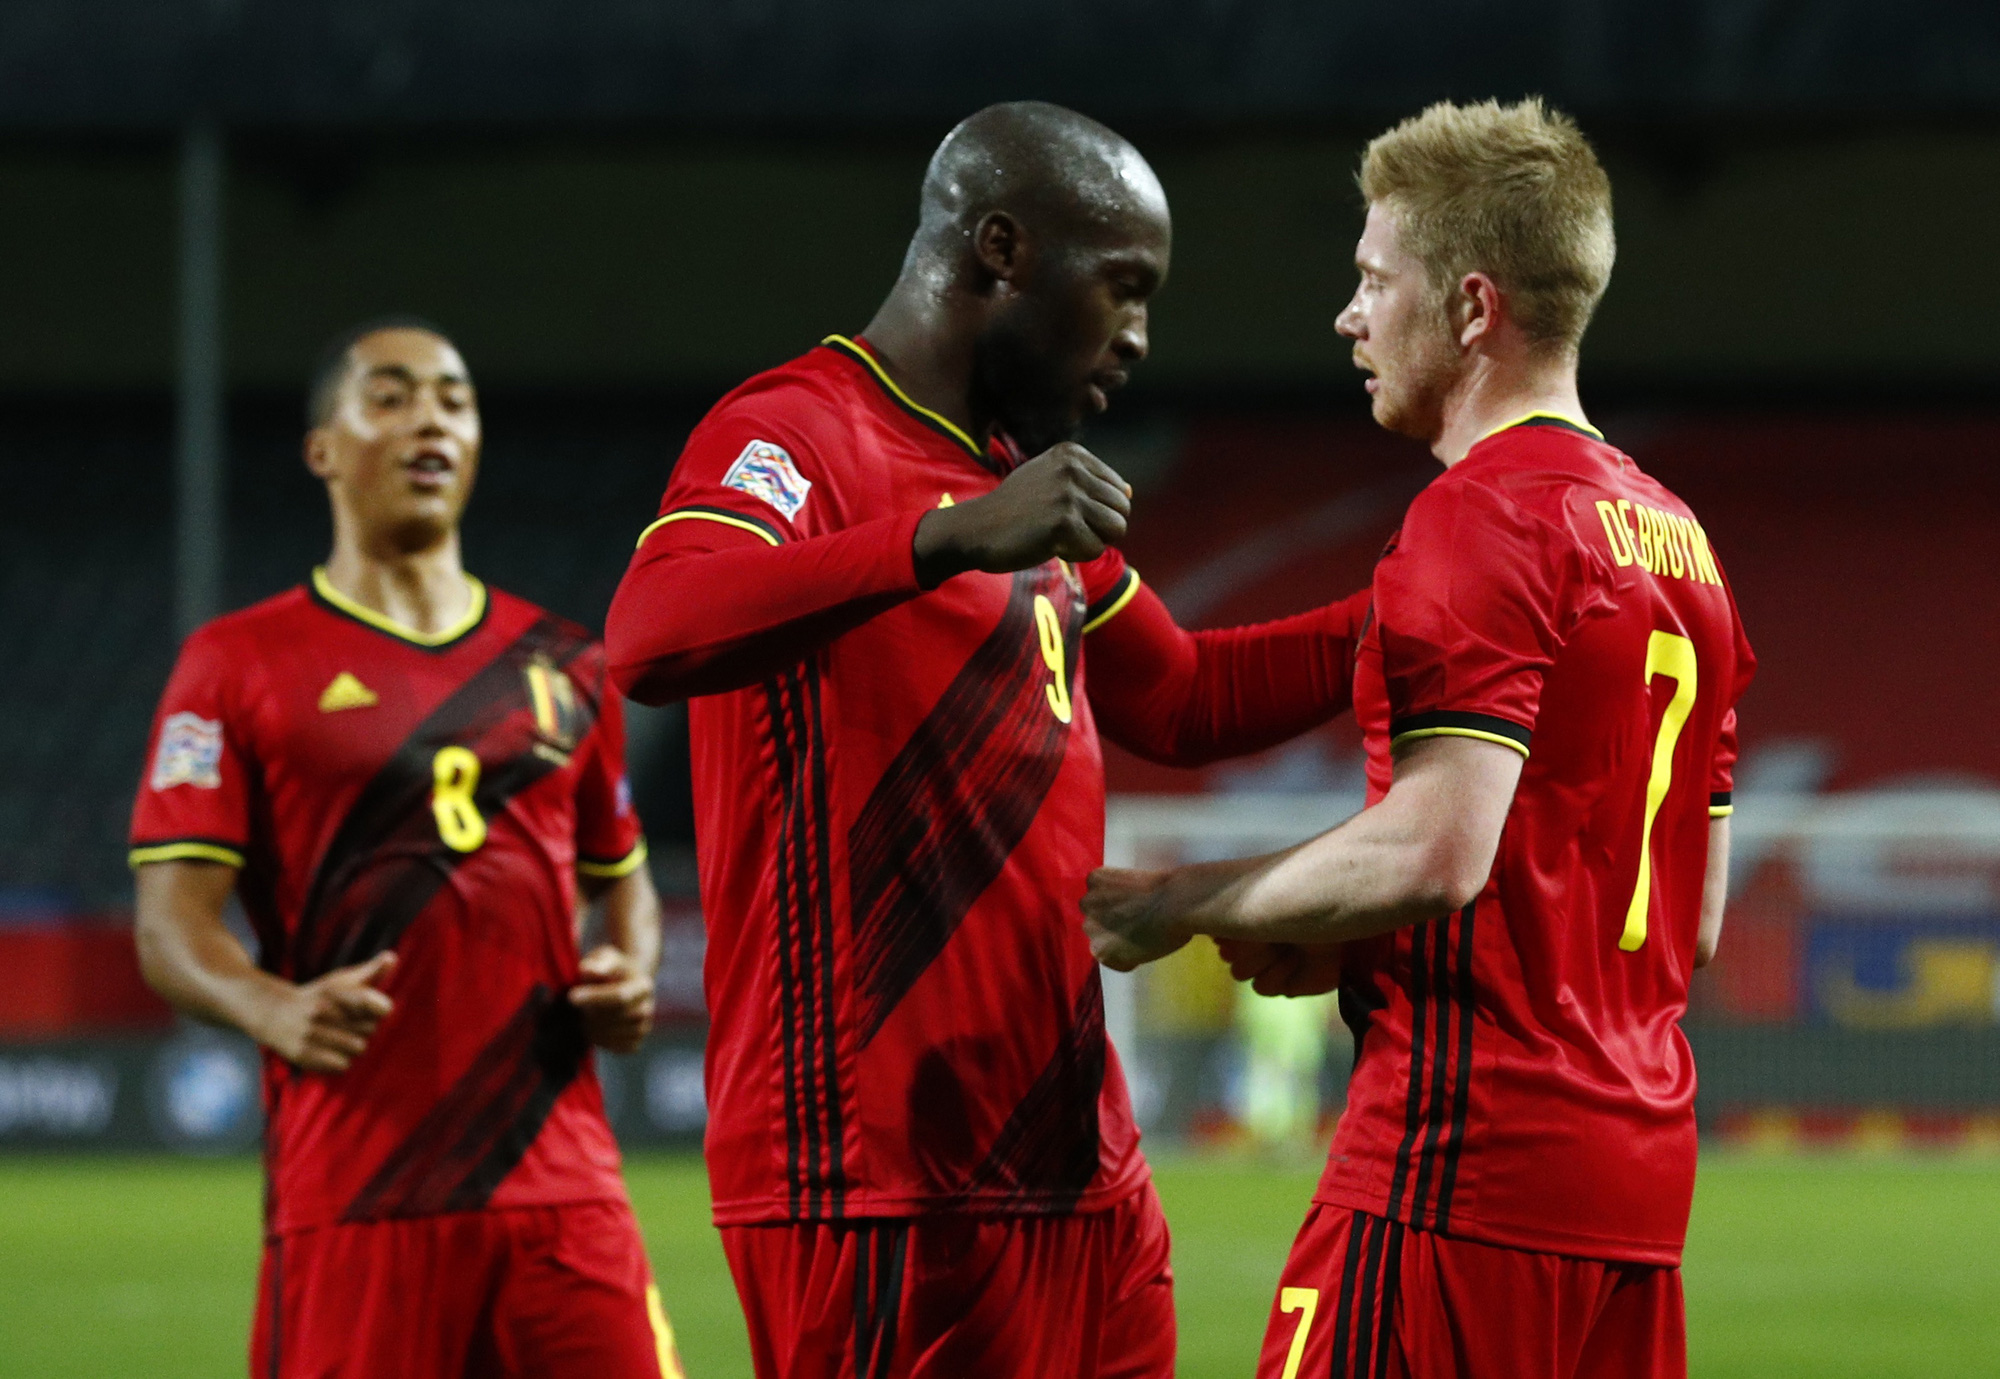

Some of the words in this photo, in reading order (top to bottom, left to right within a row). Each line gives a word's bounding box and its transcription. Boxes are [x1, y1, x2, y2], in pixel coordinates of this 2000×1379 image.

[1034, 594, 1072, 724] 9
[432, 746, 488, 853] 8
[1618, 629, 1697, 952] 7
[1280, 1286, 1319, 1379] 7
